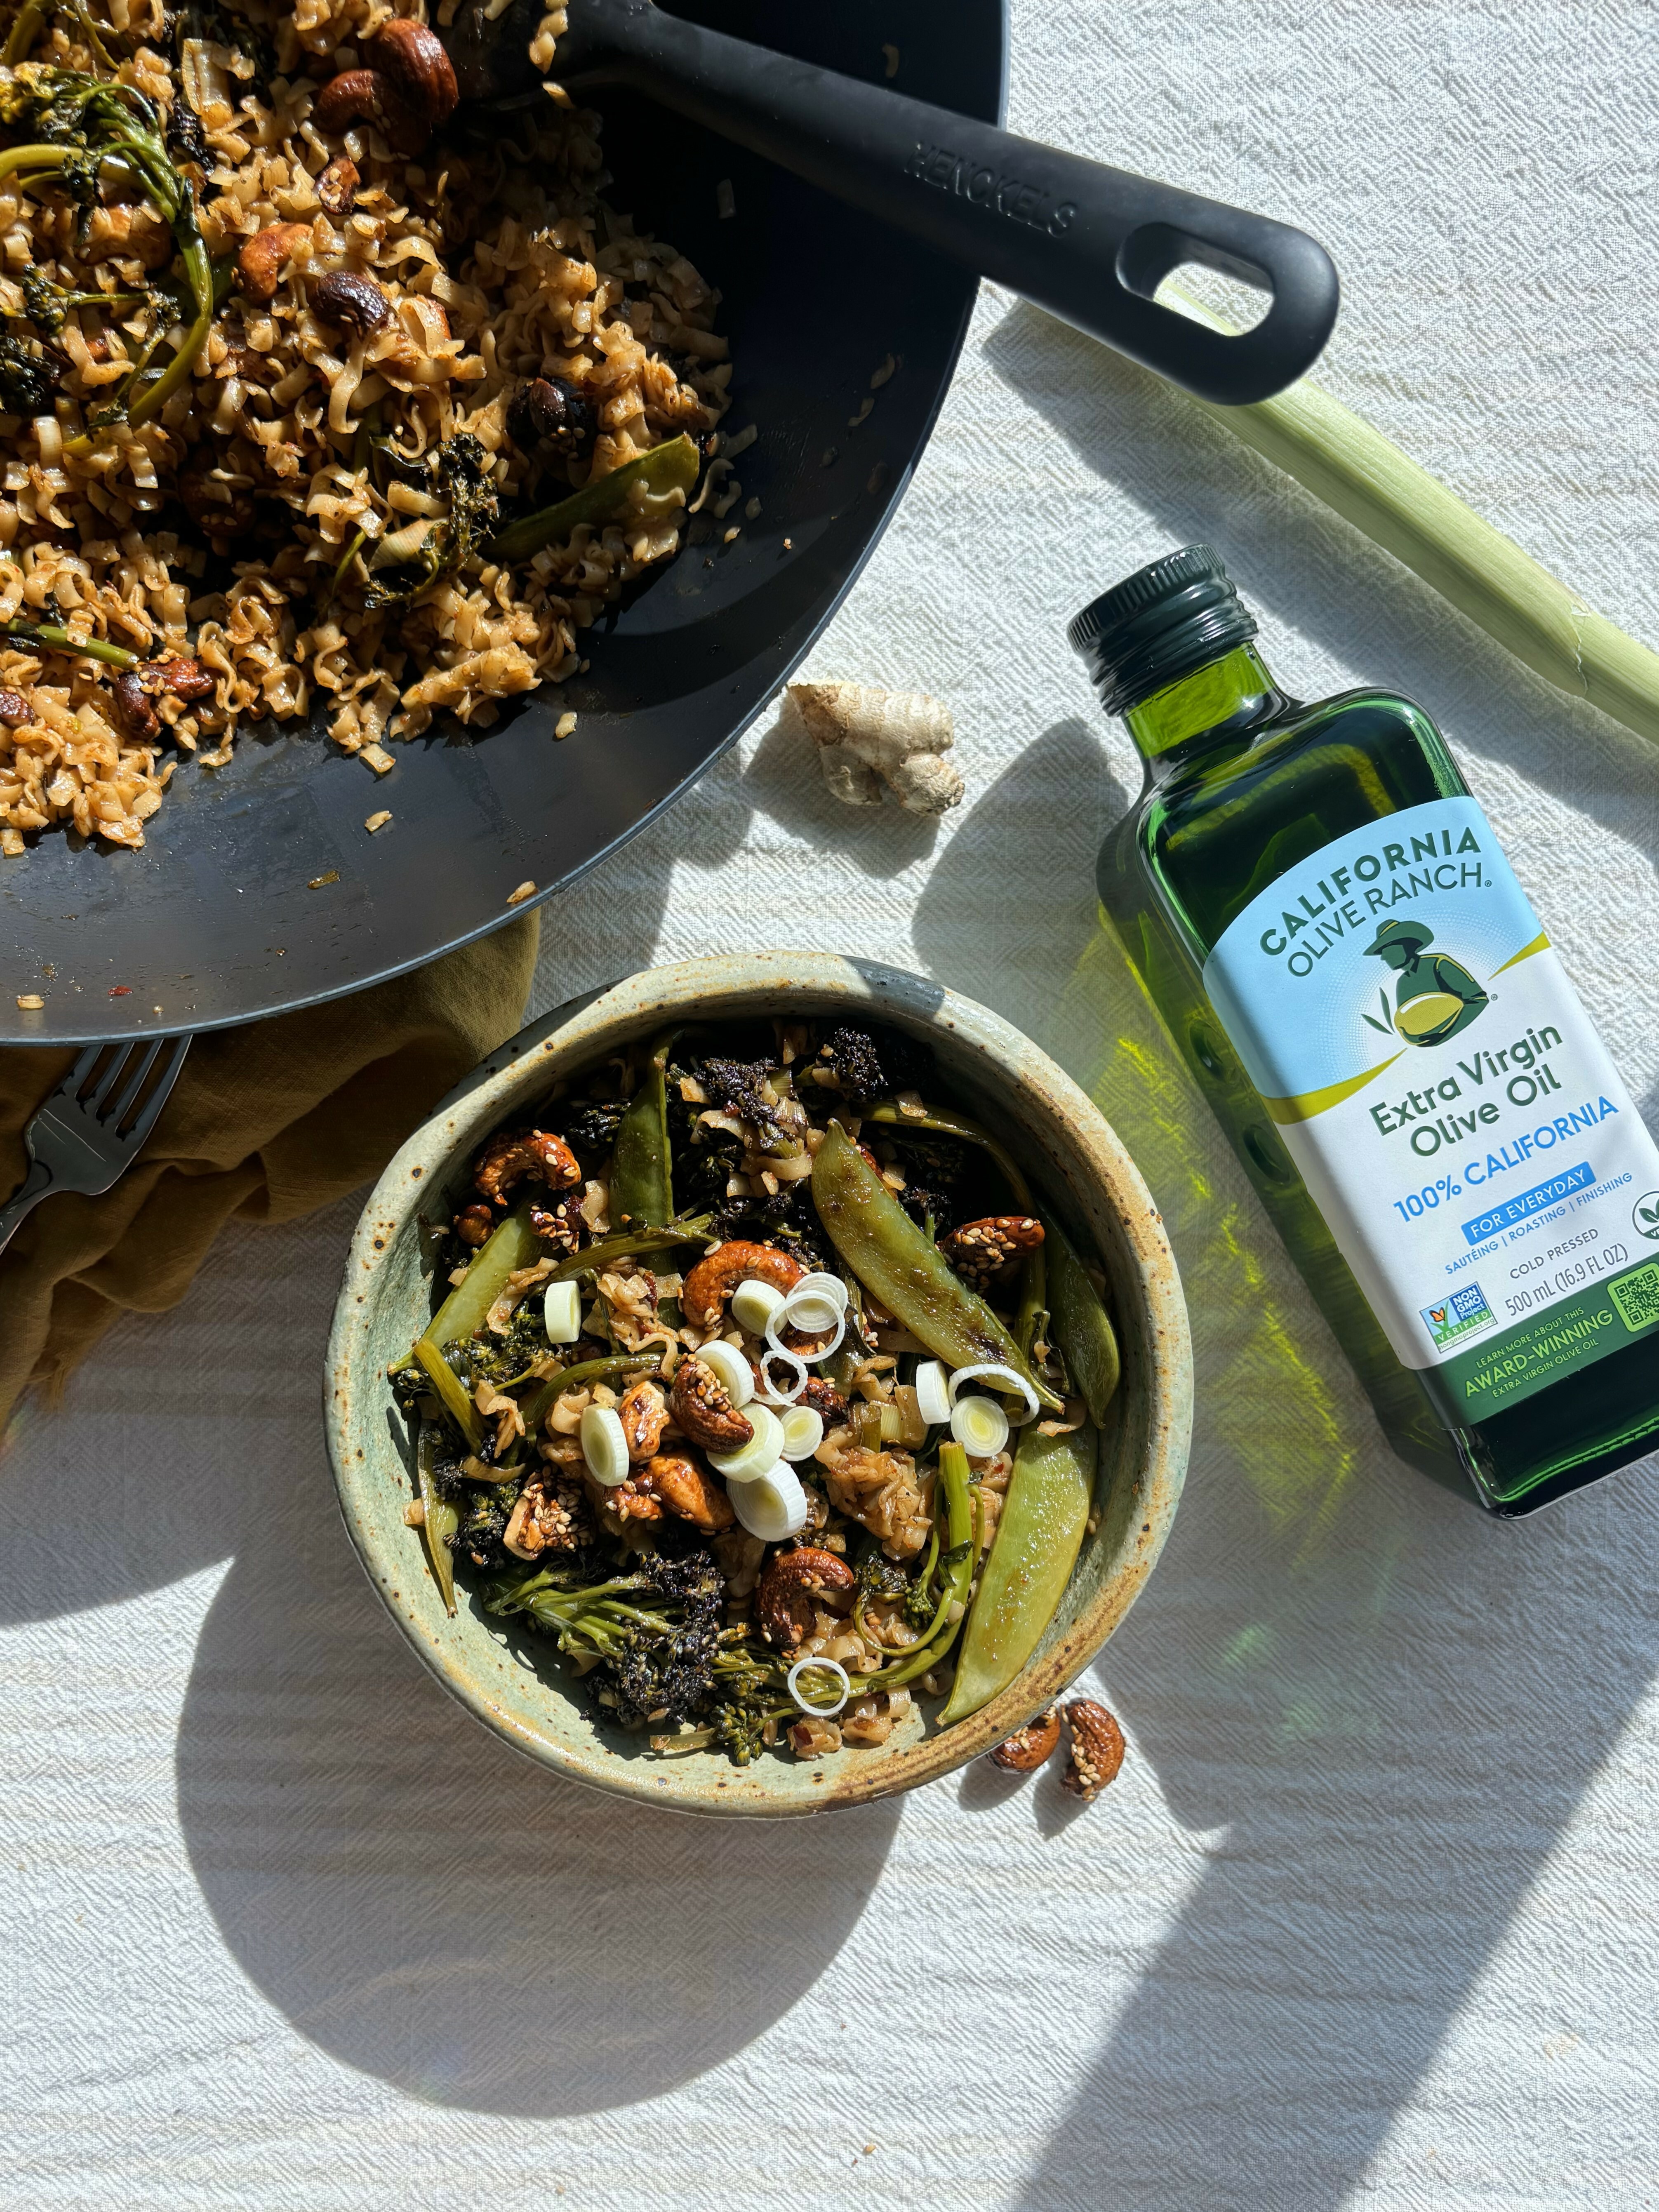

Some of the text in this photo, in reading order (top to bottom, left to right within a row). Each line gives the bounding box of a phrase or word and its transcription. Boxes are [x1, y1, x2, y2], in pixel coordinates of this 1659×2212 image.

[905, 141, 1078, 238] HENCKELS
[1260, 827, 1481, 955] CALIFORNIA
[1287, 900, 1366, 977] OLIVE
[1369, 1026, 1563, 1136] Extra Virgin
[1410, 1064, 1562, 1157] Olive Oil
[1393, 1096, 1619, 1223] 100% CALIFORNIA
[1445, 1172, 1633, 1275] SAUTÉING ROASTING FINISHING
[1470, 1168, 1586, 1238] FOR EVERYDAY
[1505, 1243, 1628, 1316] 500 mL (16.9 FL OZ)
[1510, 1228, 1598, 1279] COLD PRESSED
[1438, 1311, 1488, 1341] VERIFIED
[1453, 1287, 1478, 1306] NON
[1457, 1296, 1481, 1312] GMO
[1460, 1303, 1485, 1320] Project
[1439, 1318, 1495, 1350] nongmoproject.org
[1466, 1310, 1613, 1397] AWARD-WINNING
[1476, 1306, 1584, 1368] LEARN MORE ABOUT THIS
[1492, 1338, 1599, 1398] EXTRA VIRGIN OLIVE OIL
